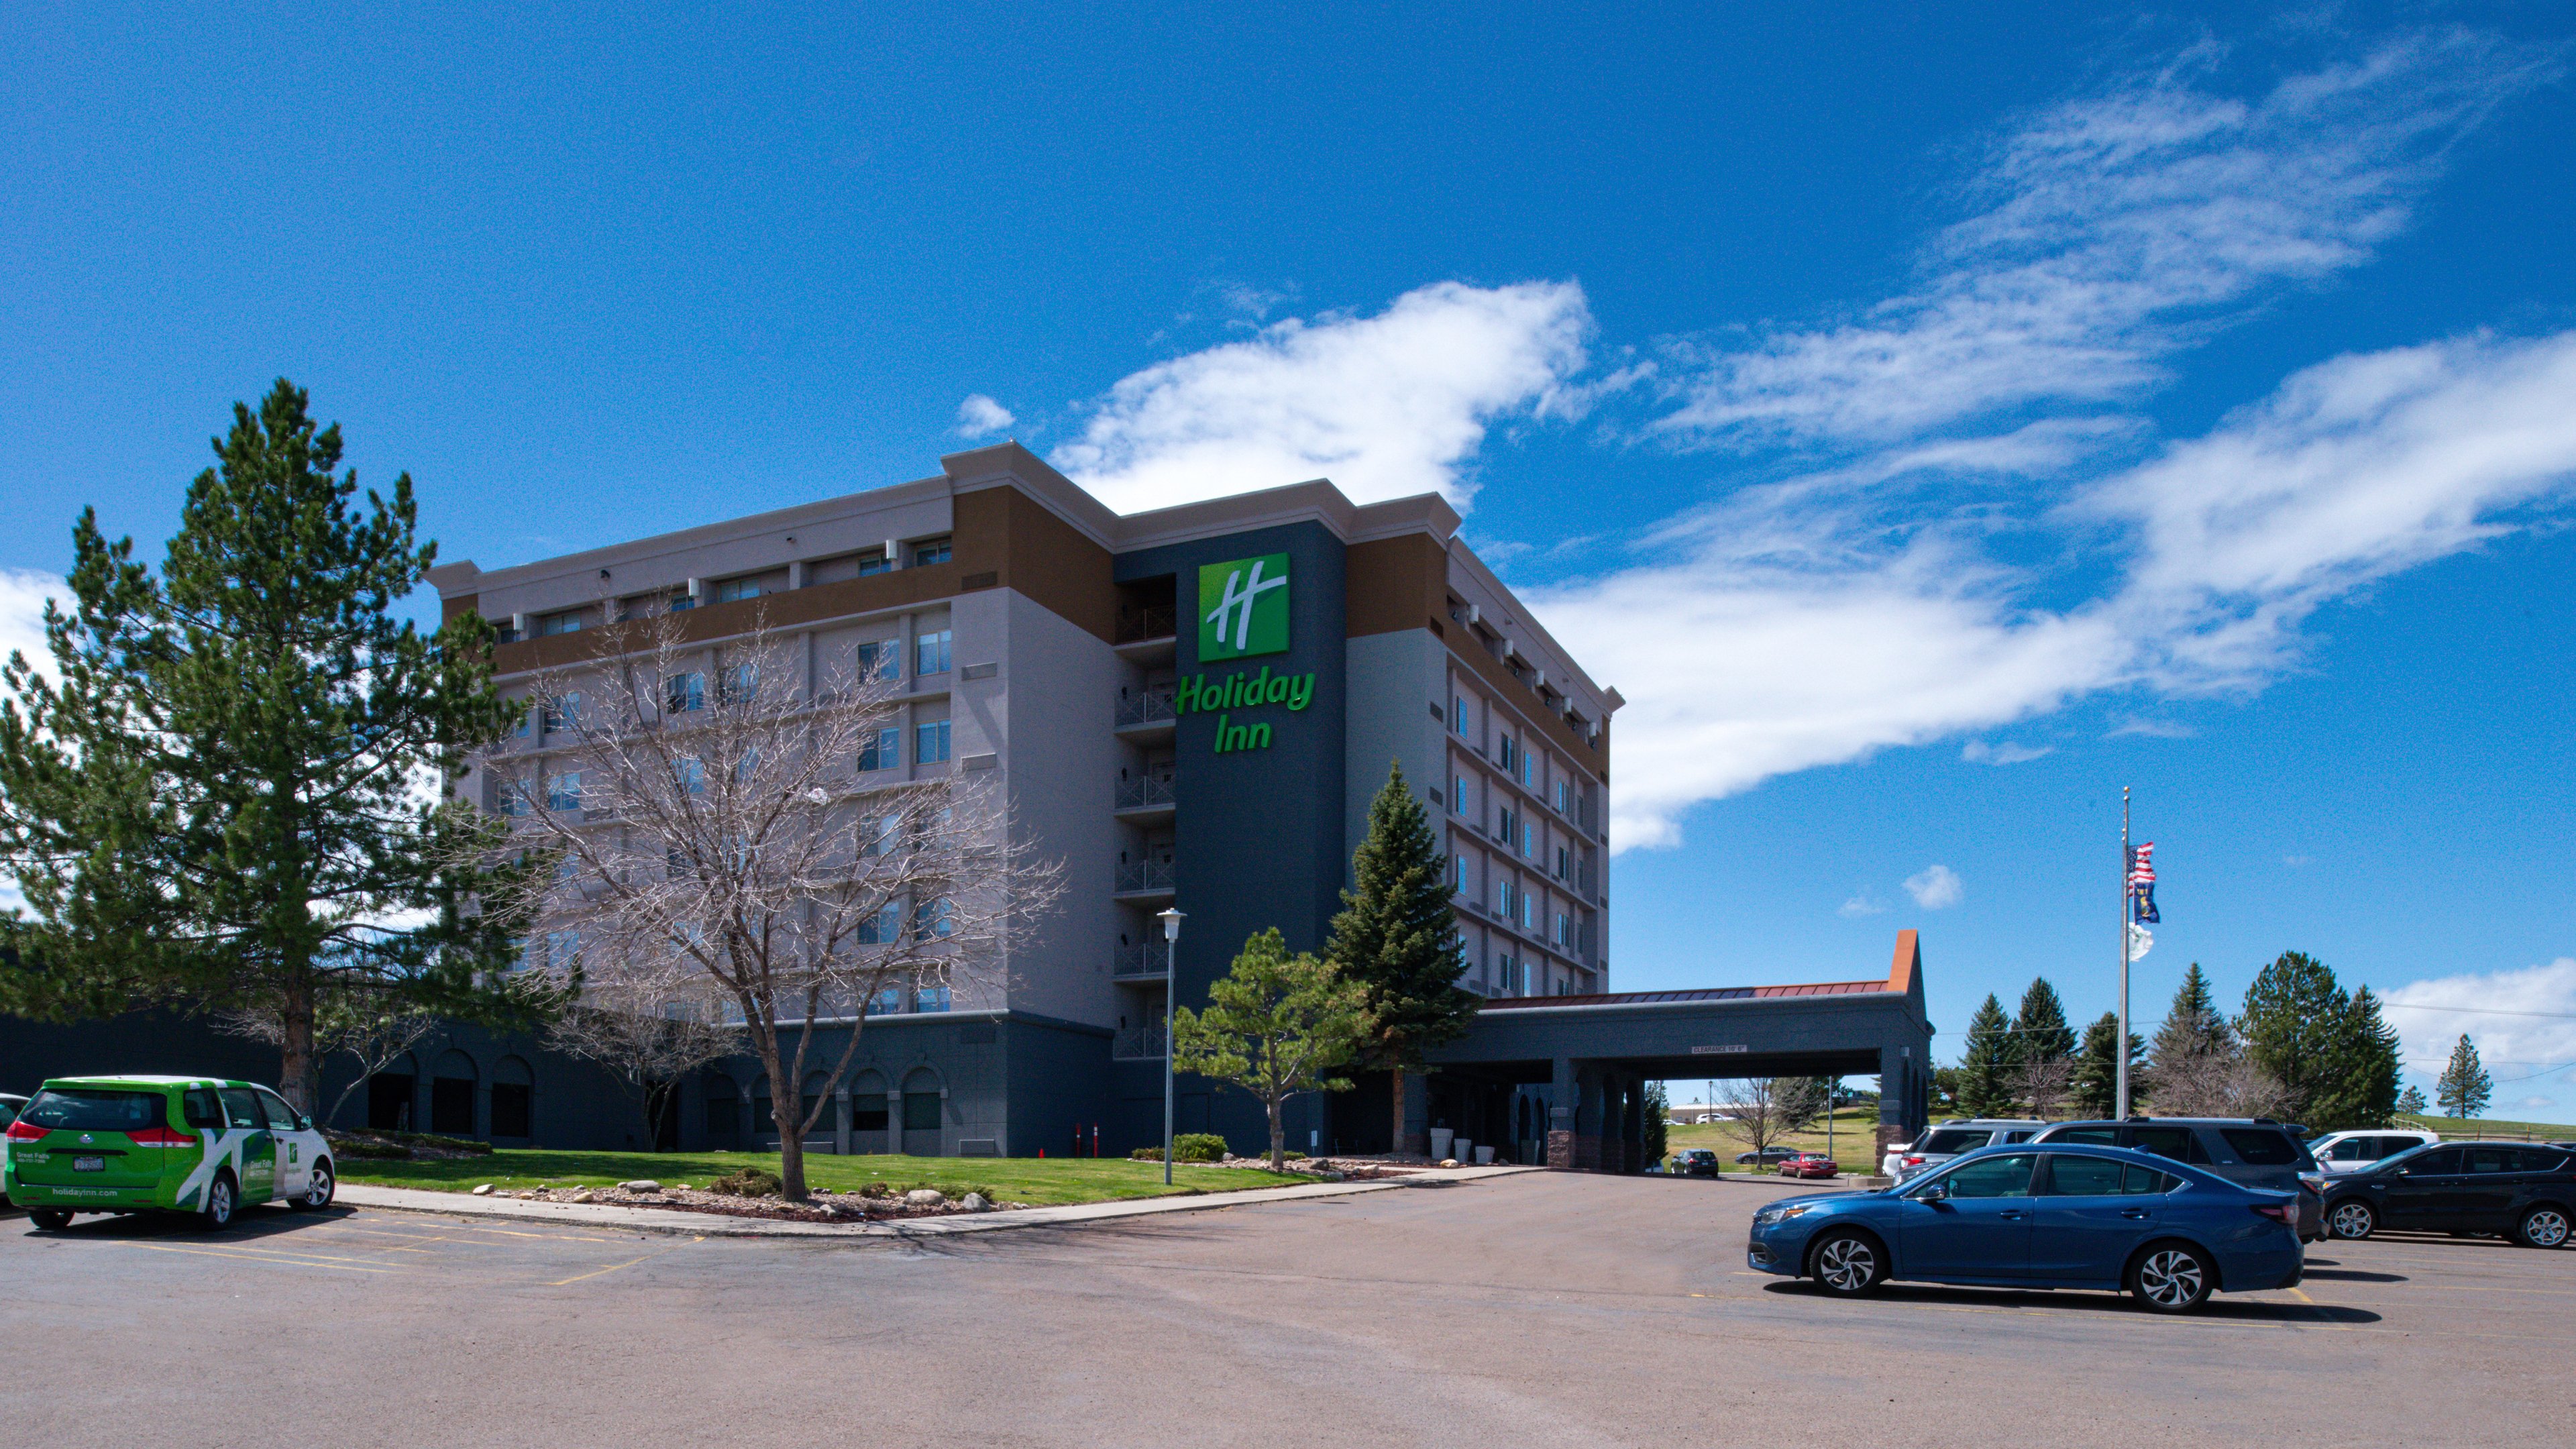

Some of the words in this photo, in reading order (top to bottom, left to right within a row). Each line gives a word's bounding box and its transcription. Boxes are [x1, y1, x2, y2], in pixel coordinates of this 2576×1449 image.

[1175, 665, 1316, 715] Holiday
[1214, 714, 1272, 753] Inn
[250, 1161, 262, 1169] Great
[52, 1188, 118, 1197] holidayinn.com
